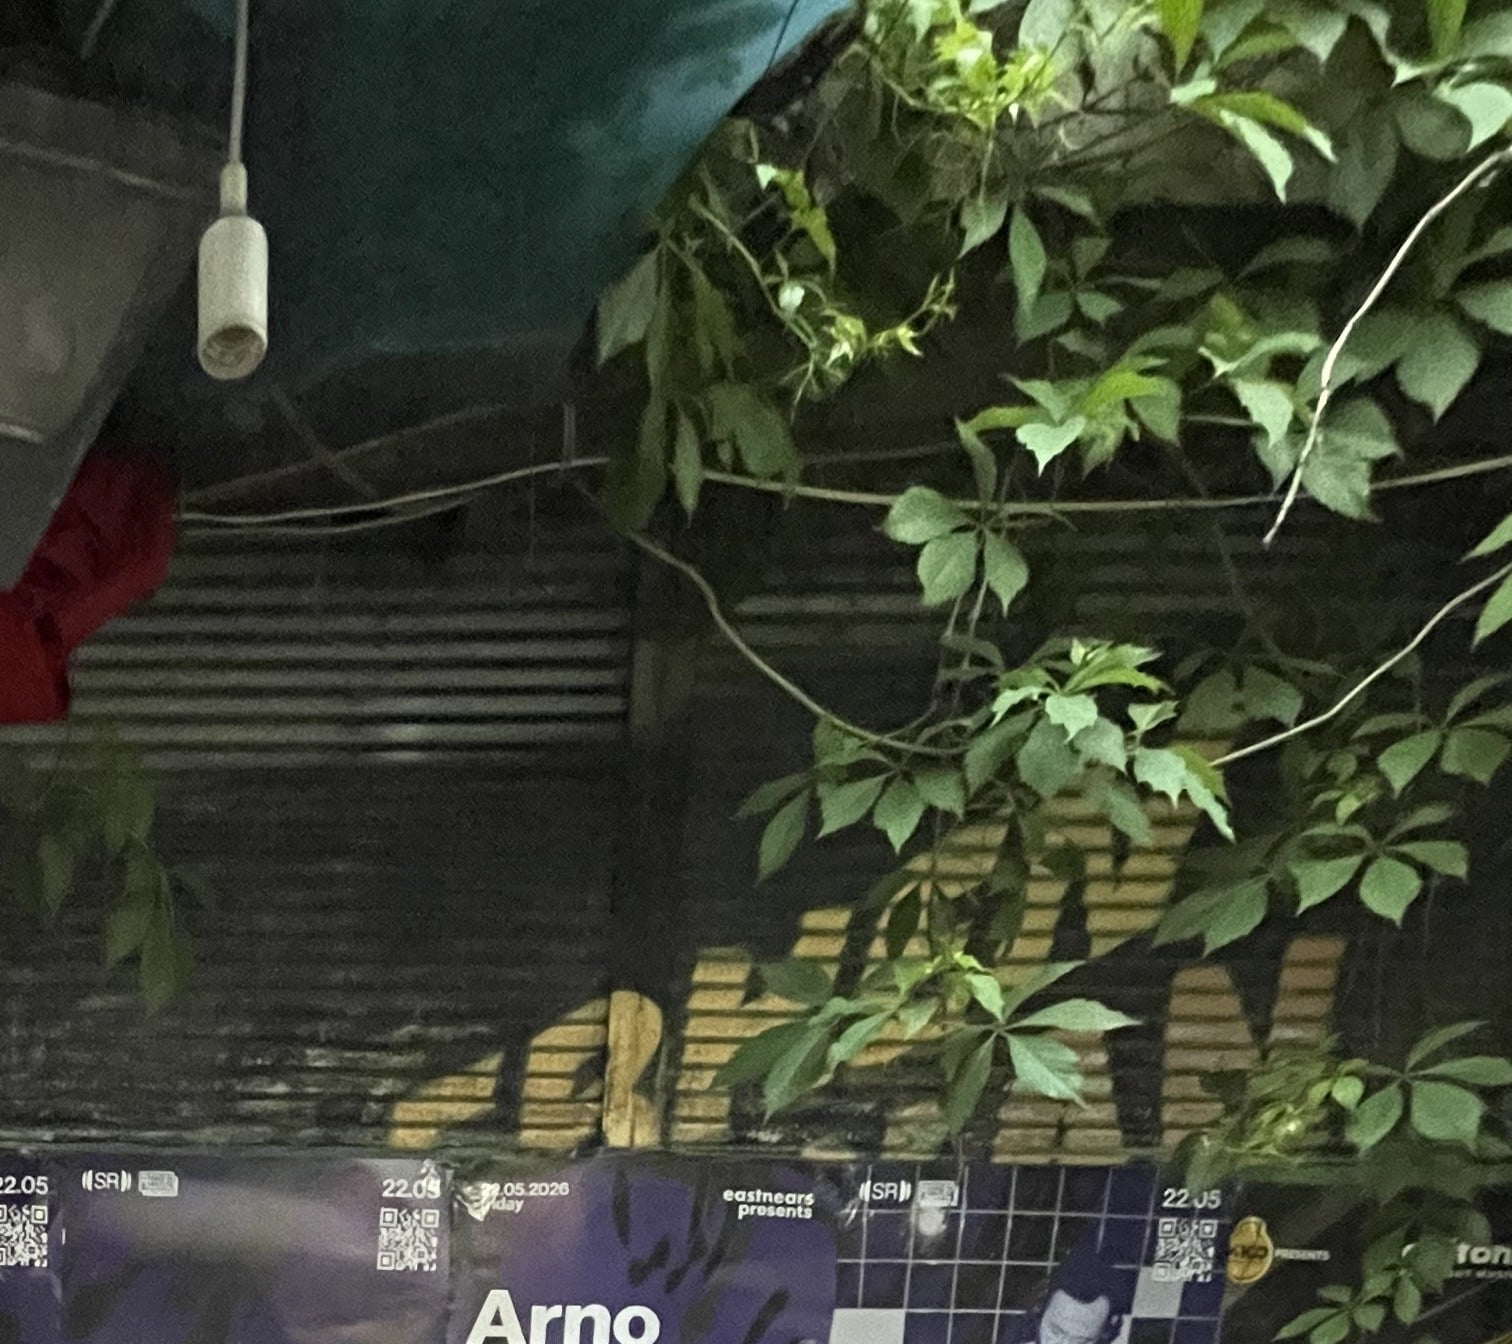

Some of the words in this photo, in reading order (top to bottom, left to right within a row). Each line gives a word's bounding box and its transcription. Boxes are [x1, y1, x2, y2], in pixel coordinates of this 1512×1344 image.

[93, 1173, 120, 1190] SR
[722, 1188, 815, 1206] eastnears
[871, 1182, 898, 1199] SR
[738, 1203, 813, 1219] presents
